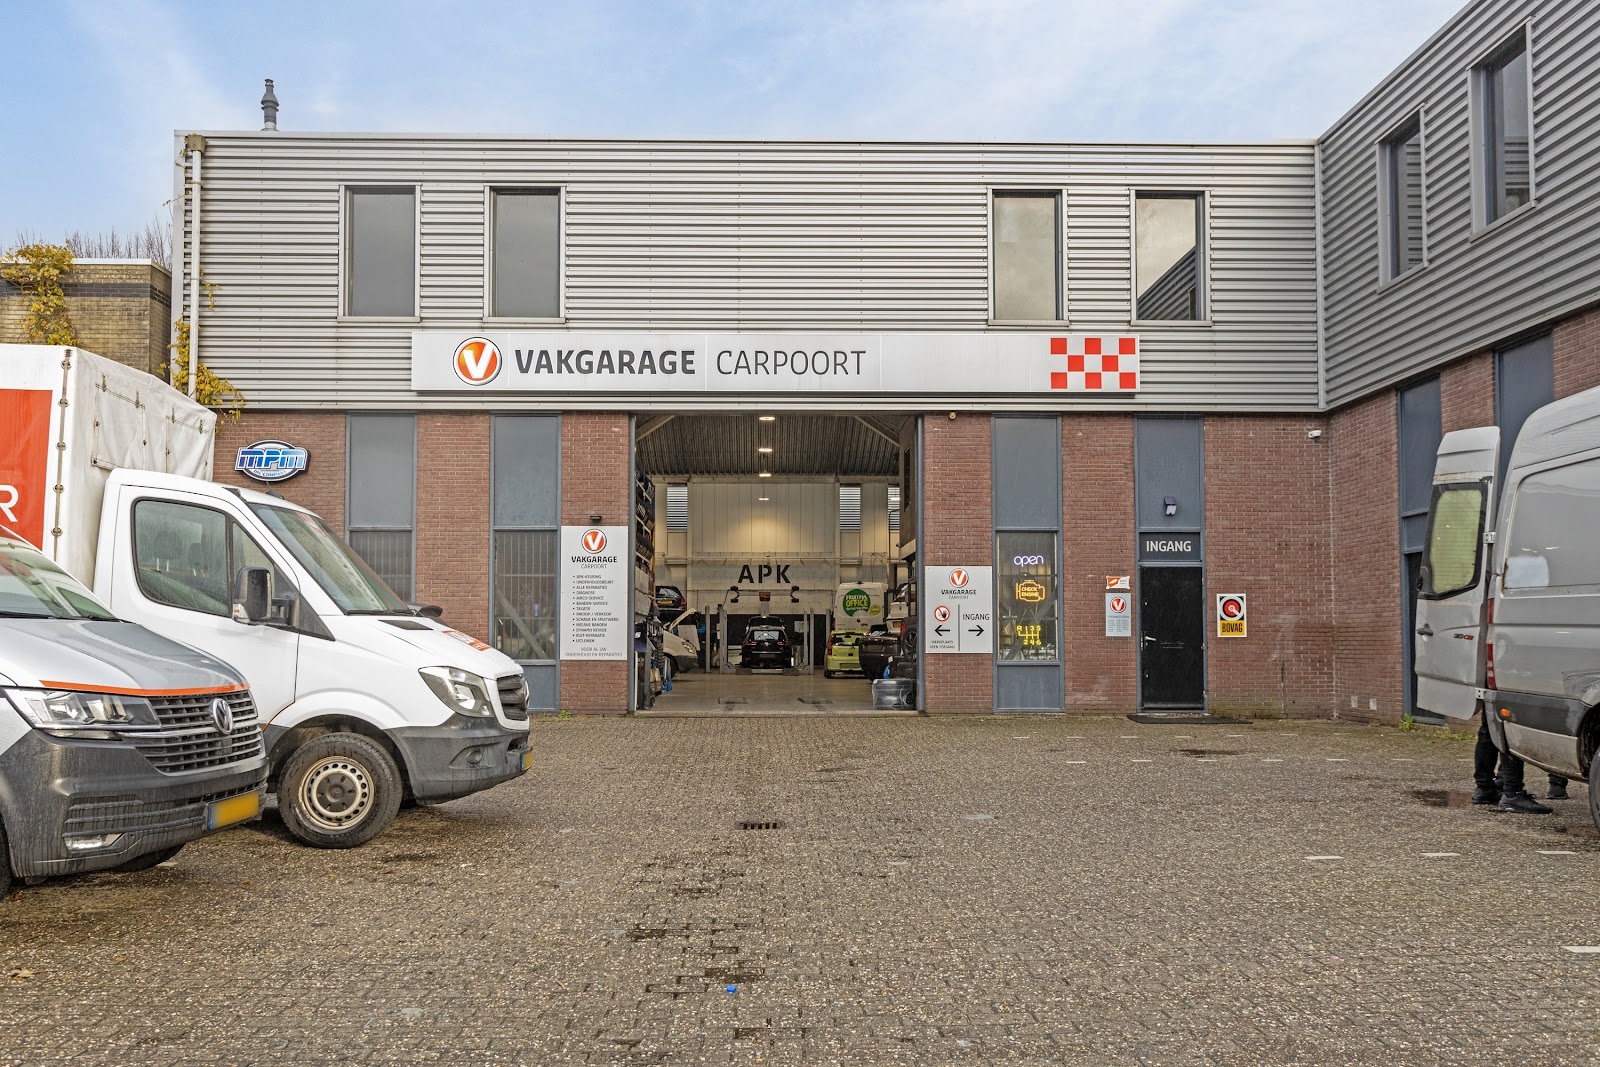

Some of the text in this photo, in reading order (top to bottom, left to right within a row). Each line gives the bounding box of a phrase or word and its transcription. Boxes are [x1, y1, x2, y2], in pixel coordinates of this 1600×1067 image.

[515, 350, 866, 375] VAKGARAGE CARPOORT
[1146, 540, 1192, 552] INGANG
[1014, 555, 1044, 567] open
[738, 564, 791, 584] APK
[1222, 622, 1243, 633] BOVAG
